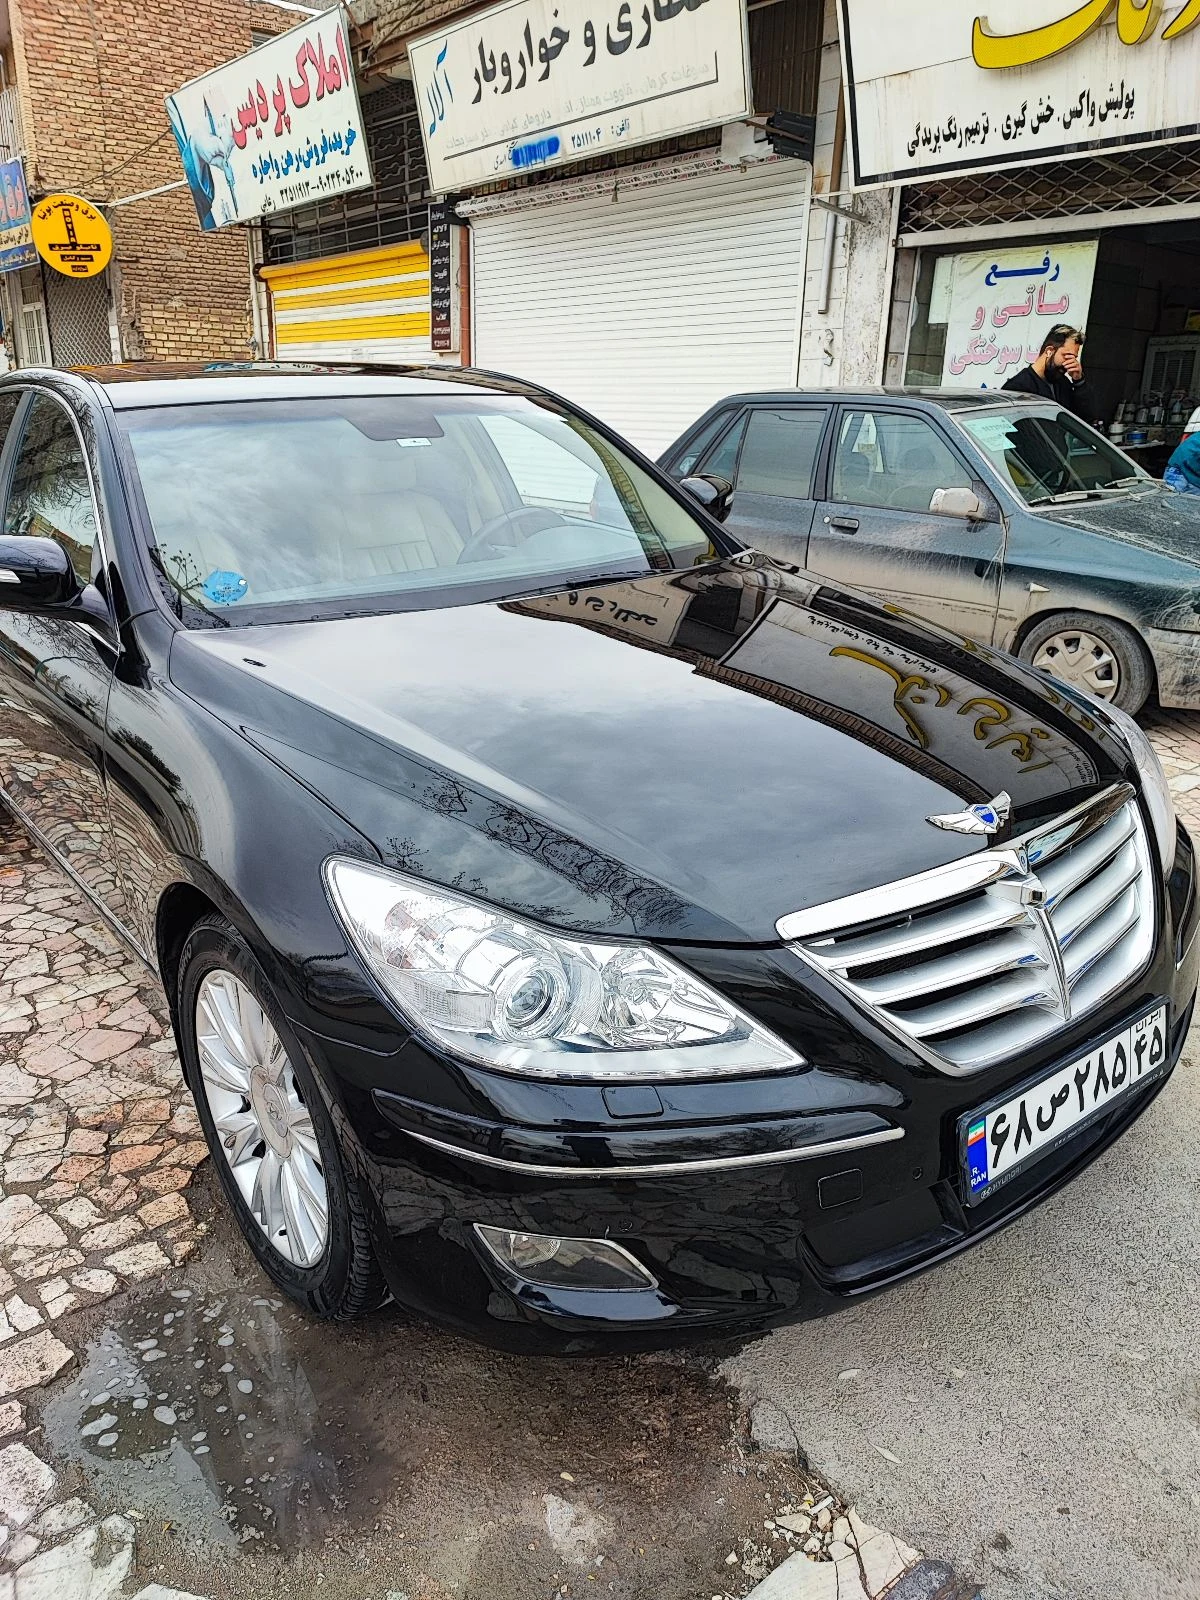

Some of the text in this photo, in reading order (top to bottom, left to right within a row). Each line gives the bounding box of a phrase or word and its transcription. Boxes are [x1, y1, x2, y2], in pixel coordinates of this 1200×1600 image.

[471, 8, 570, 104] خواروبار
[582, 20, 597, 67] و
[231, 22, 349, 149] املاک پردیس
[907, 79, 1135, 157] پولیش واکس خش گیری ترمیم رنگ پریدگی
[984, 249, 1060, 287] رفع
[970, 282, 1070, 331] ماتی و
[949, 333, 1023, 376] سوختگی
[1135, 1010, 1161, 1033] ایران
[1134, 1026, 1163, 1075] ۴۵
[970, 1171, 987, 1188] RAN
[993, 1165, 1022, 1190] HYUNDAI
